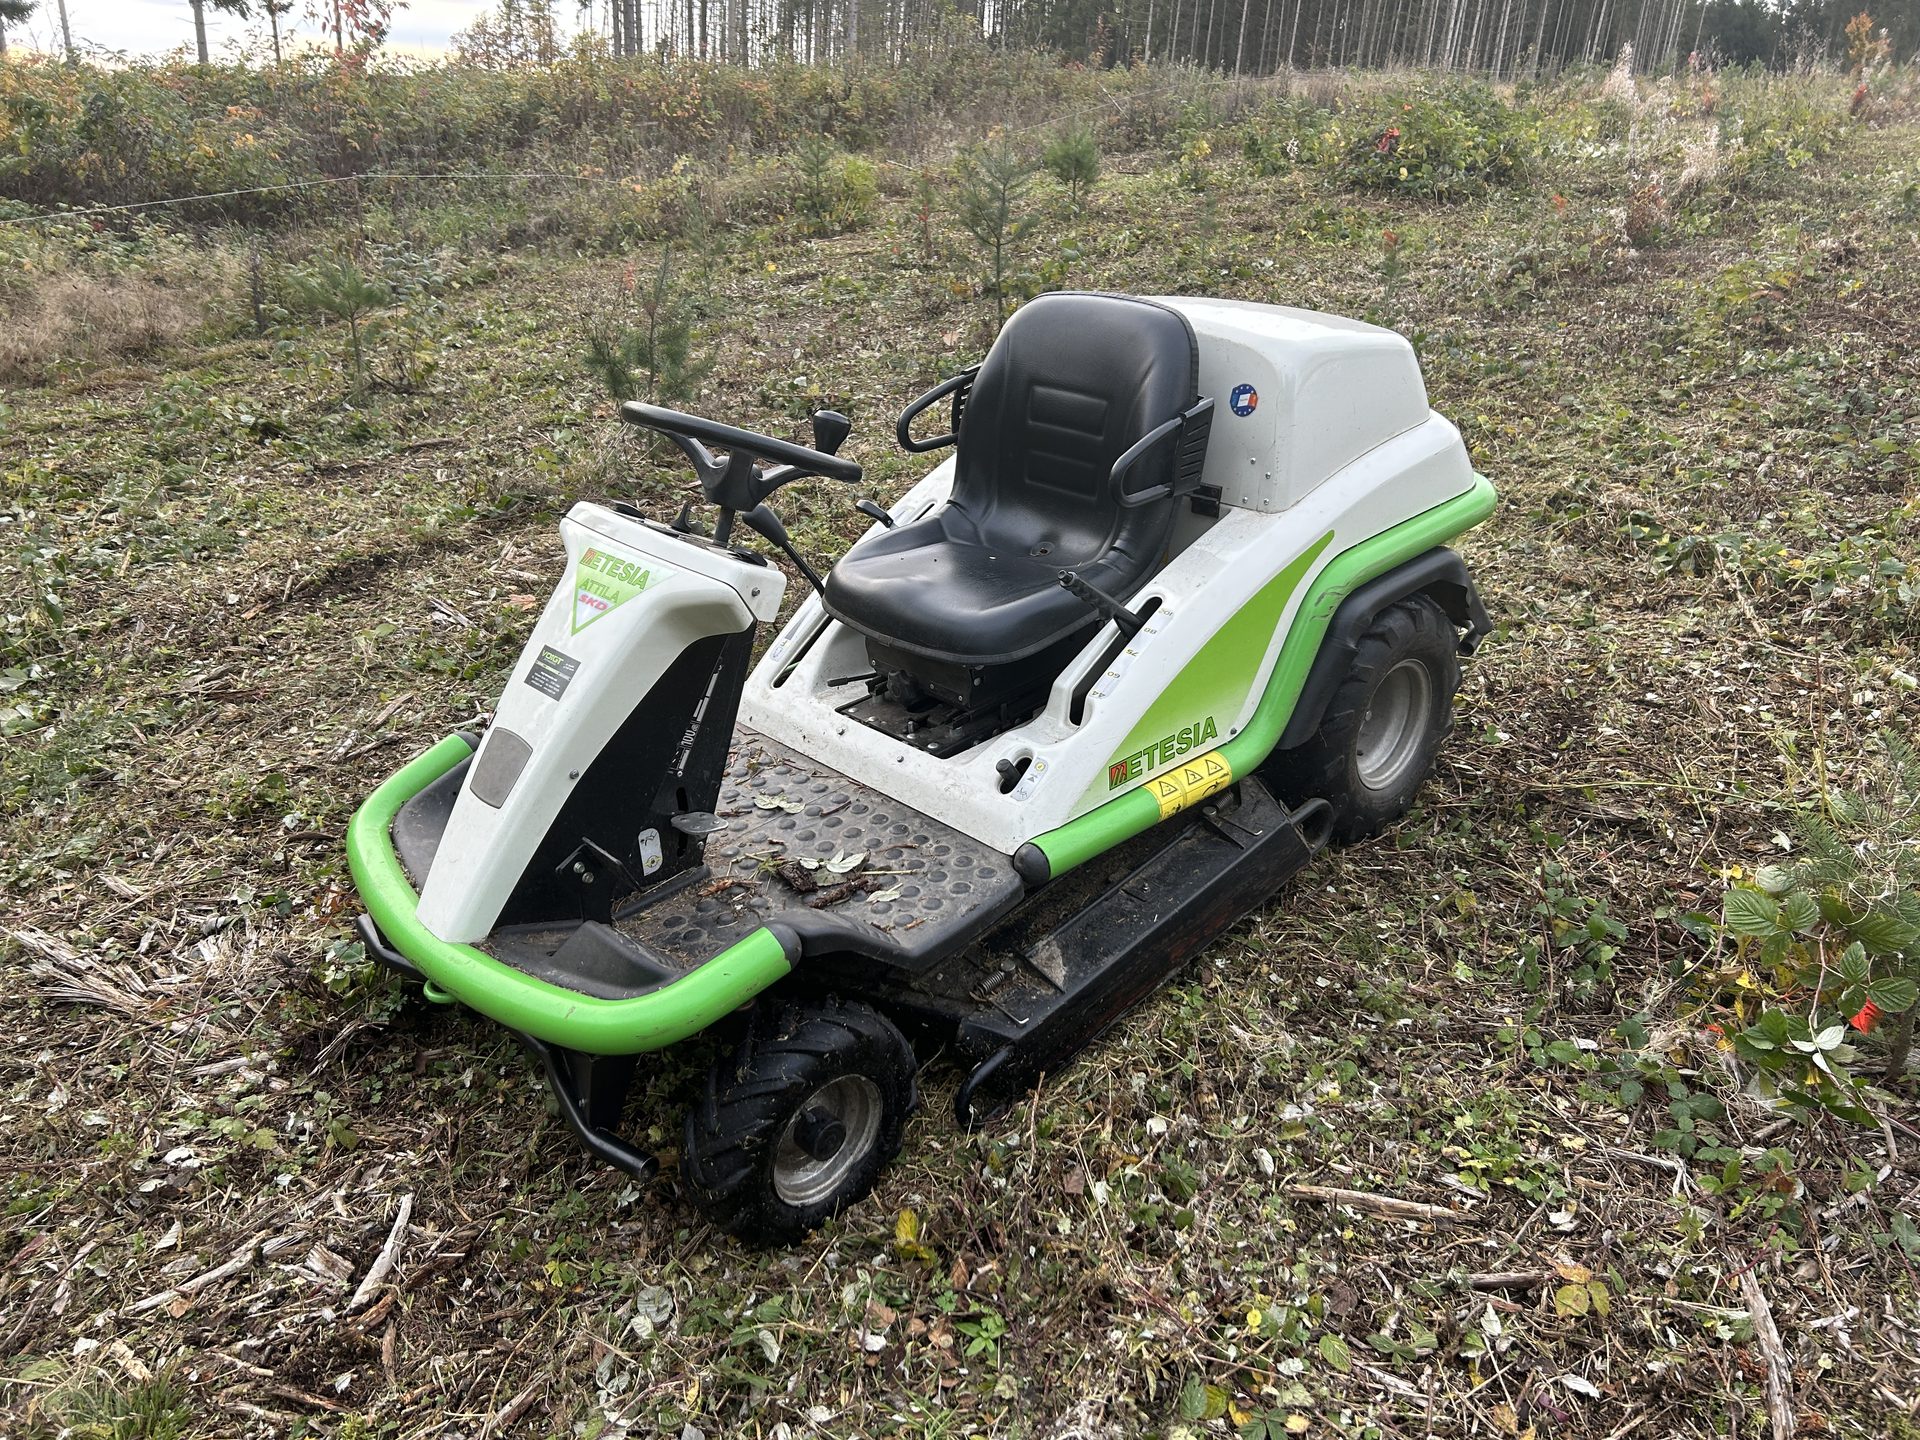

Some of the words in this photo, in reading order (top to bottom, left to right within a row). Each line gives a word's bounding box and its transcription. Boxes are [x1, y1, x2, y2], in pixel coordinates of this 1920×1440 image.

[590, 550, 650, 590] ETESIA
[578, 593, 609, 611] SKD
[580, 578, 620, 604] ATTILA
[1126, 715, 1218, 779] ETESIA
